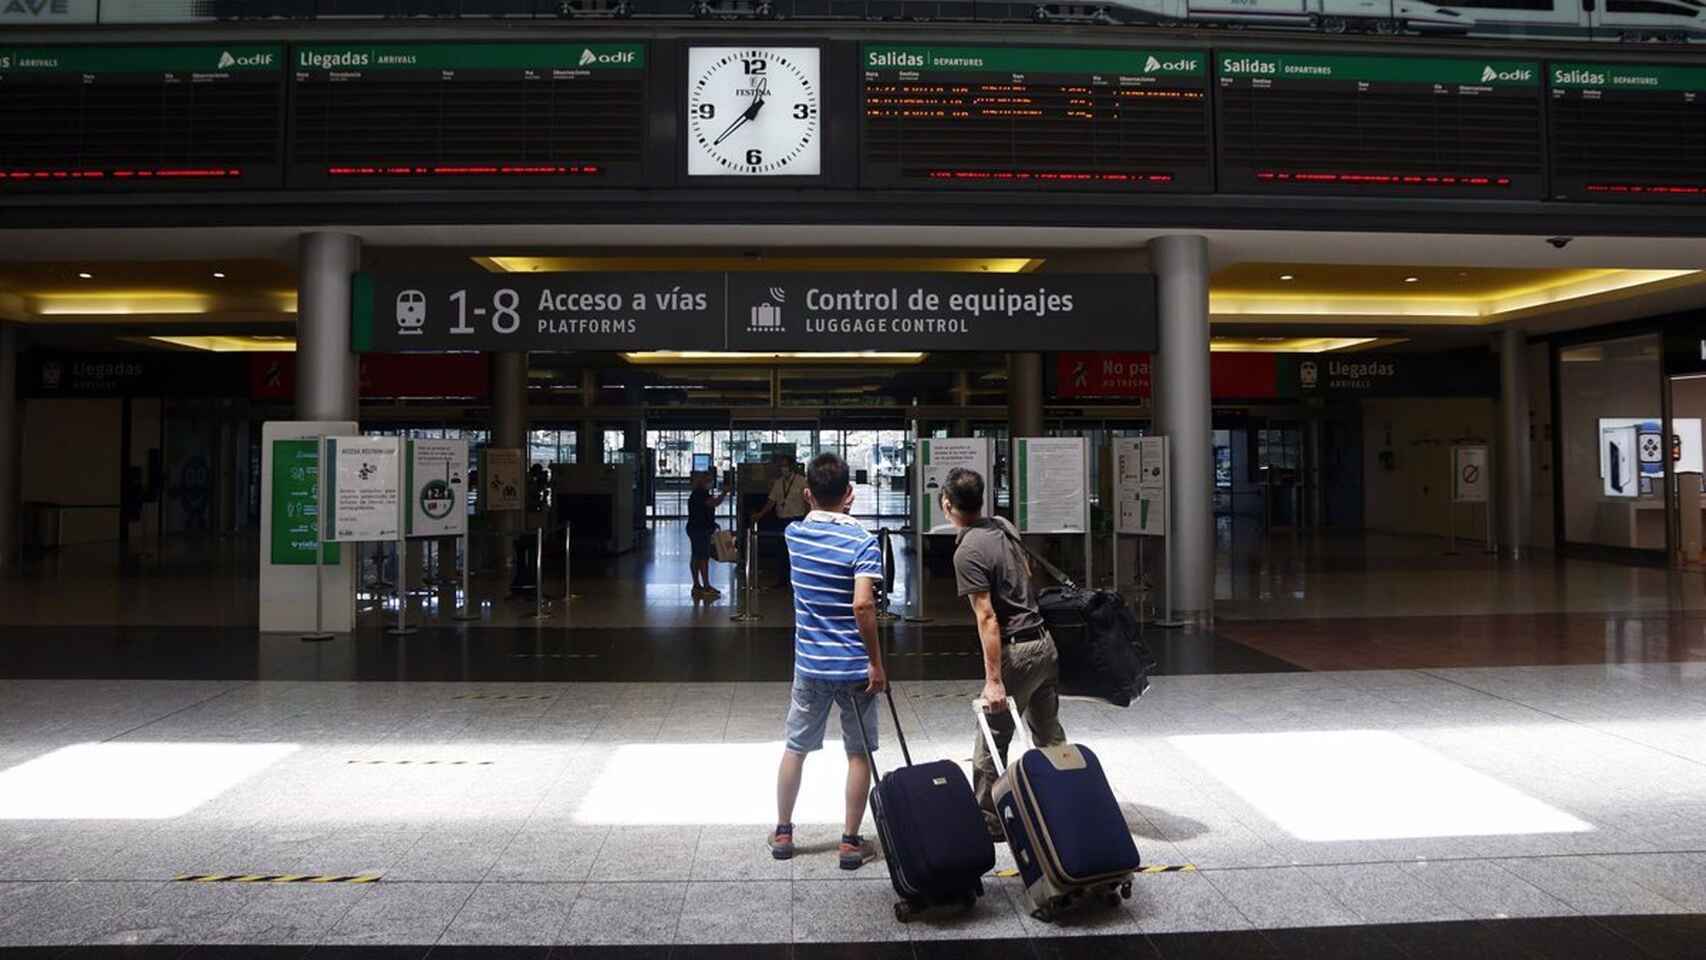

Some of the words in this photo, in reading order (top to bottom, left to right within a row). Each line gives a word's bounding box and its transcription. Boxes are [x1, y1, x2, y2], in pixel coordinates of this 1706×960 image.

[236, 53, 273, 65] adif
[300, 50, 368, 69] Llegadas
[378, 55, 417, 64] ARRIVALS
[598, 52, 635, 63] adif
[869, 52, 924, 66] Salidas
[934, 58, 983, 67] DEPARTURES
[1162, 59, 1198, 71] adif
[741, 58, 767, 75] 12
[1223, 58, 1276, 74] Salidas
[1284, 65, 1332, 75] DEPARTURES
[1498, 69, 1533, 81] adif
[1555, 70, 1605, 85] Salidas
[698, 103, 715, 120] 9
[792, 103, 809, 120] 3
[745, 149, 763, 166] 6
[538, 289, 622, 311] Acceso
[631, 293, 647, 311] a
[655, 286, 707, 311] vías
[806, 288, 898, 312] Control
[908, 287, 939, 312] de
[949, 288, 1074, 317] equipajes
[448, 288, 521, 334] 1-8
[537, 318, 636, 334] PLATFORMS
[806, 318, 887, 333] LUGGAGE
[892, 318, 969, 334] CONTROL
[1103, 360, 1123, 375] No
[1129, 361, 1149, 377] pa
[1329, 360, 1394, 379] Llegadas
